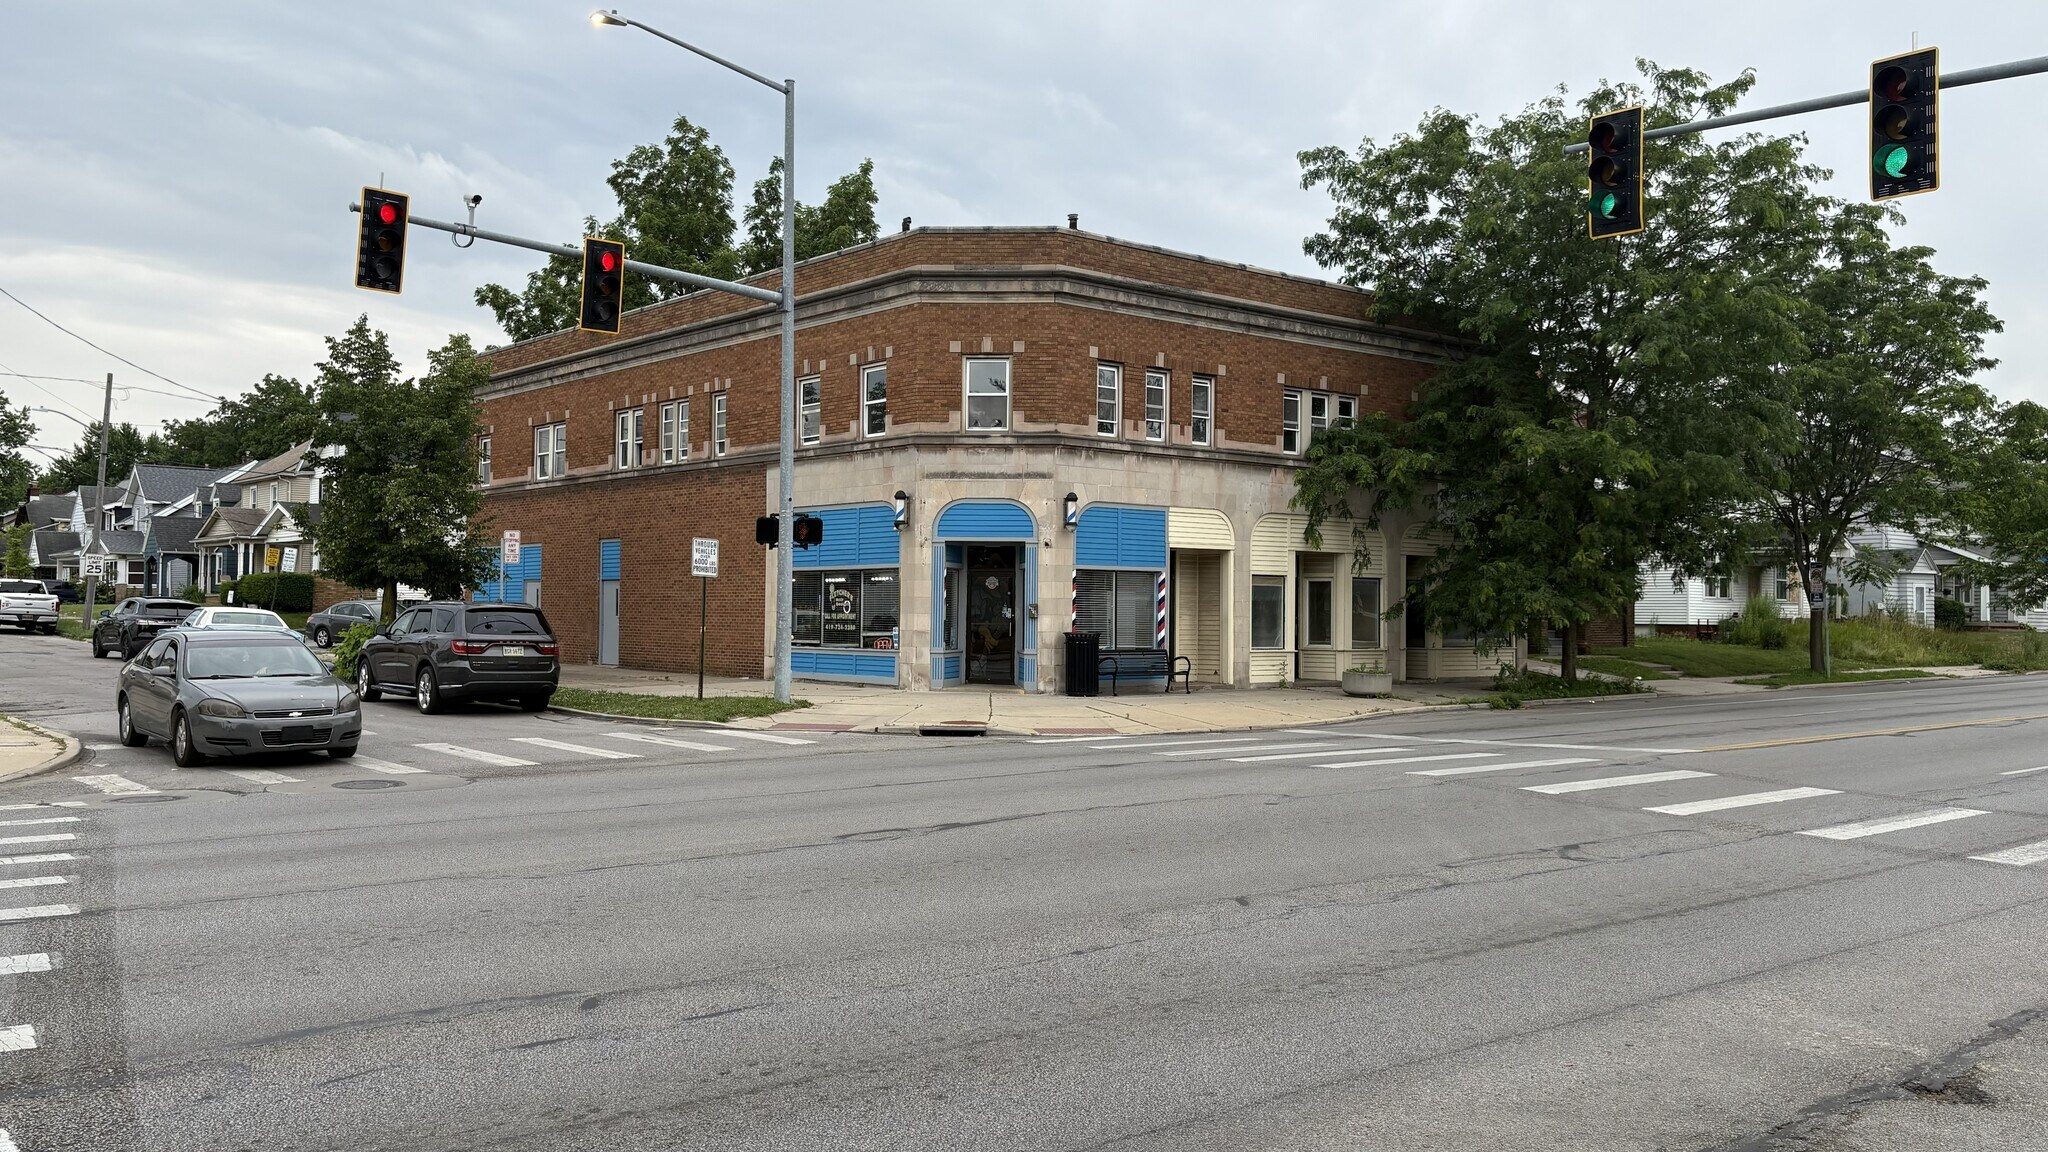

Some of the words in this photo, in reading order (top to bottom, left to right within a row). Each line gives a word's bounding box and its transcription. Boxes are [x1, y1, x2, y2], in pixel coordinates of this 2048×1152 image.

[695, 540, 717, 549] THROUGH
[695, 548, 716, 556] VEHICLES
[694, 558, 709, 566] 6000
[87, 565, 102, 574] 25
[693, 565, 717, 574] PROHIBITED
